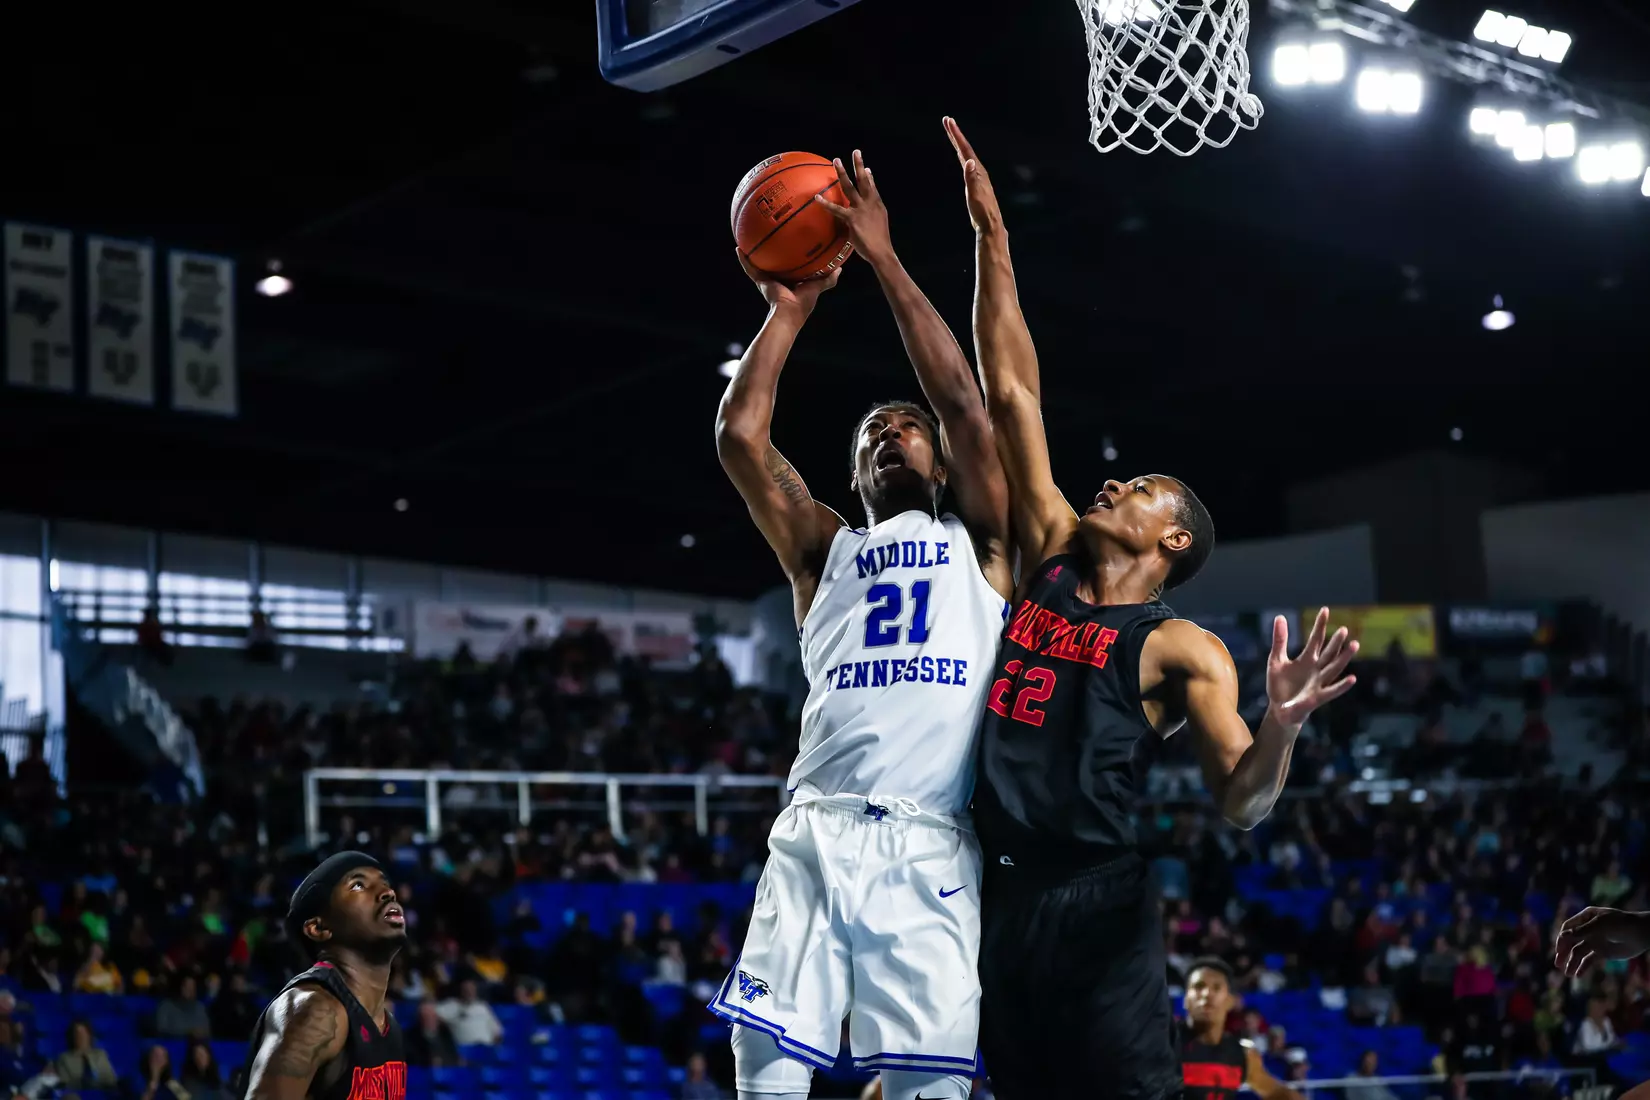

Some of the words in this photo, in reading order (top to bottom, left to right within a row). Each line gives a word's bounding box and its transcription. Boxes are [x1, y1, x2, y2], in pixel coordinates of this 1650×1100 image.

[855, 541, 950, 579] MIDDLE
[862, 578, 932, 649] 21
[826, 655, 968, 692] TENNESSEE
[986, 659, 1057, 727] 22
